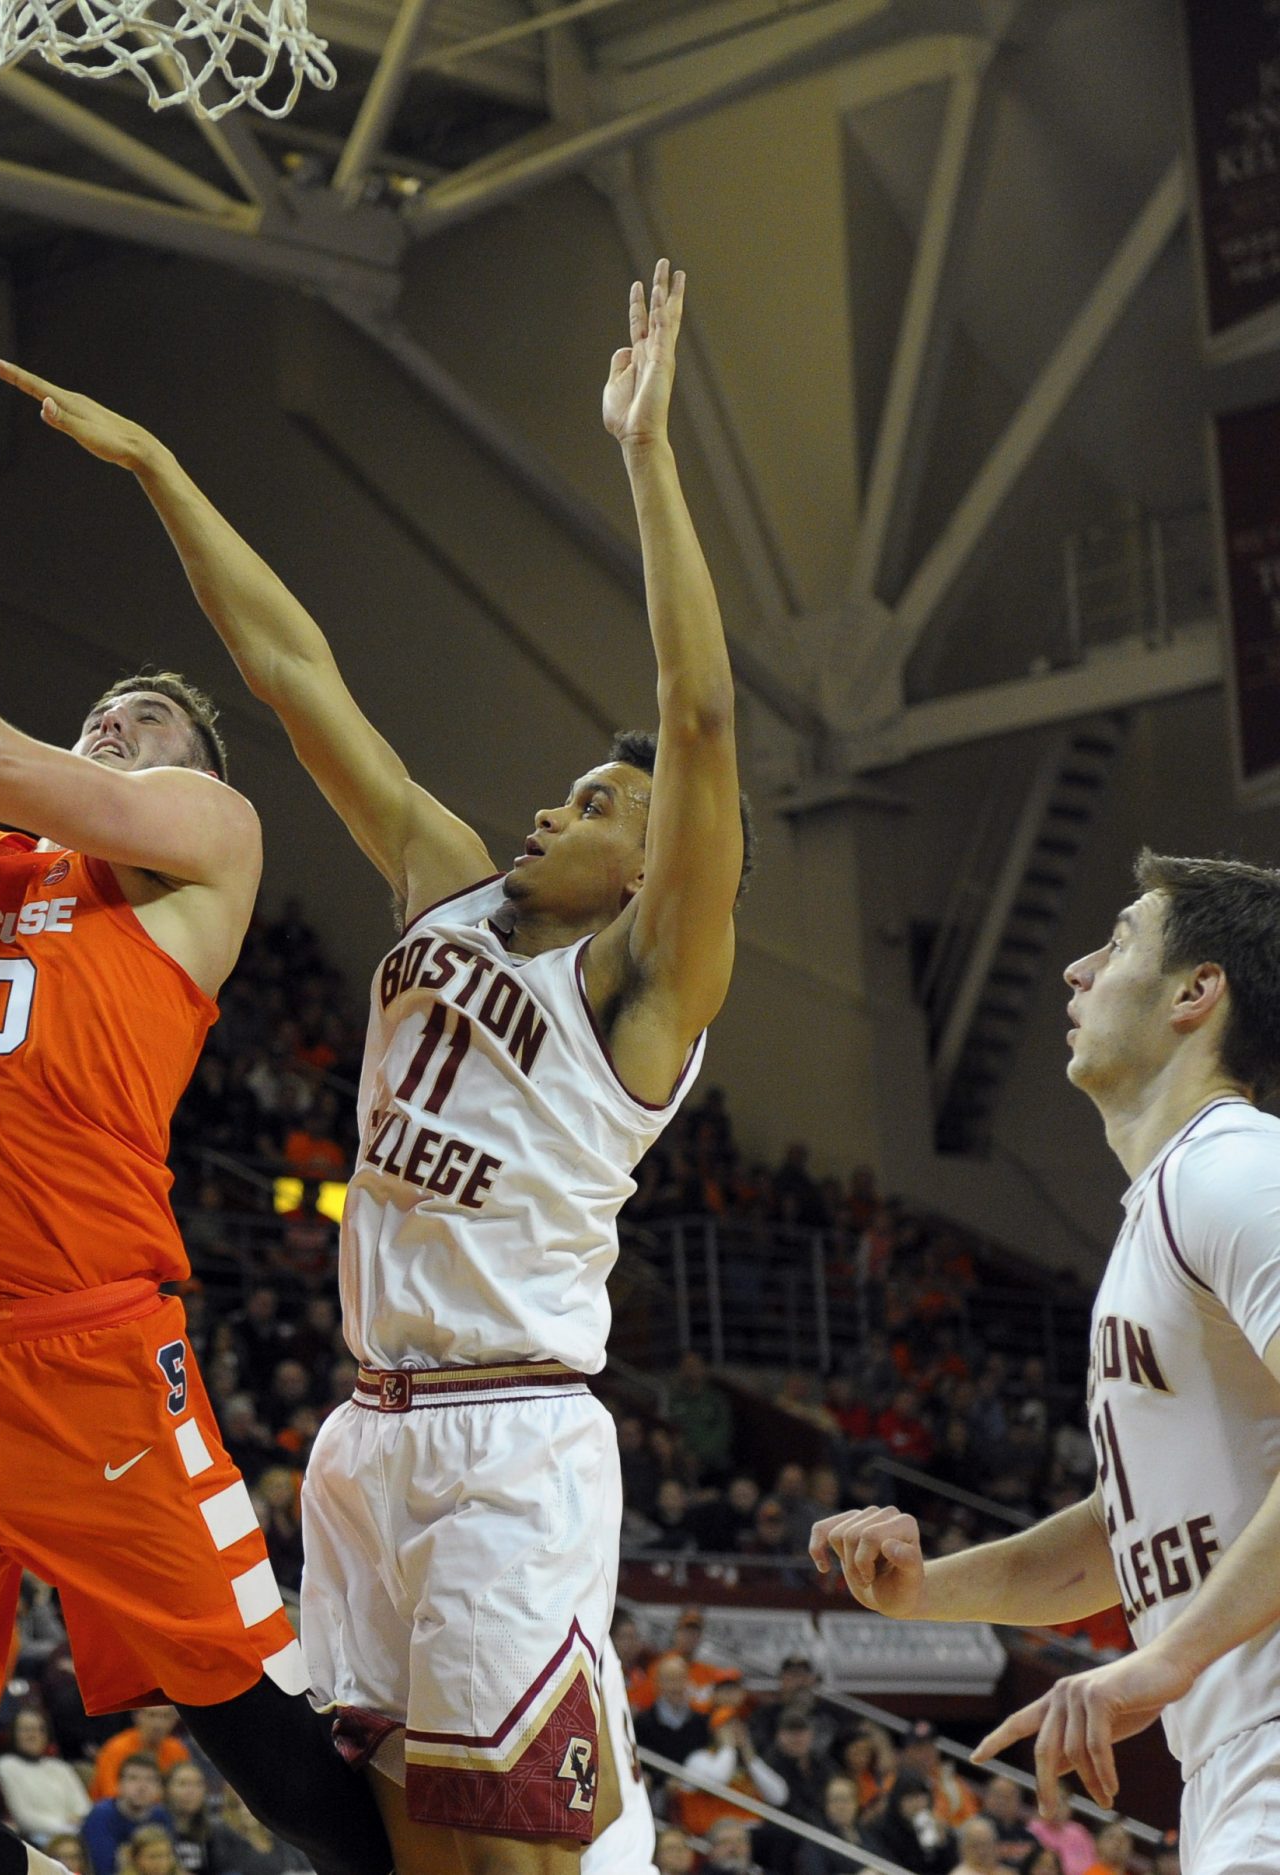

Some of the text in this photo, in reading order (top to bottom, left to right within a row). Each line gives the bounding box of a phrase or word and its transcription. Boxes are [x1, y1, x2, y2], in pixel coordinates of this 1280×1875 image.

[380, 937, 549, 1077] BOSTON
[394, 1002, 471, 1115] 11
[156, 1339, 187, 1416] S
